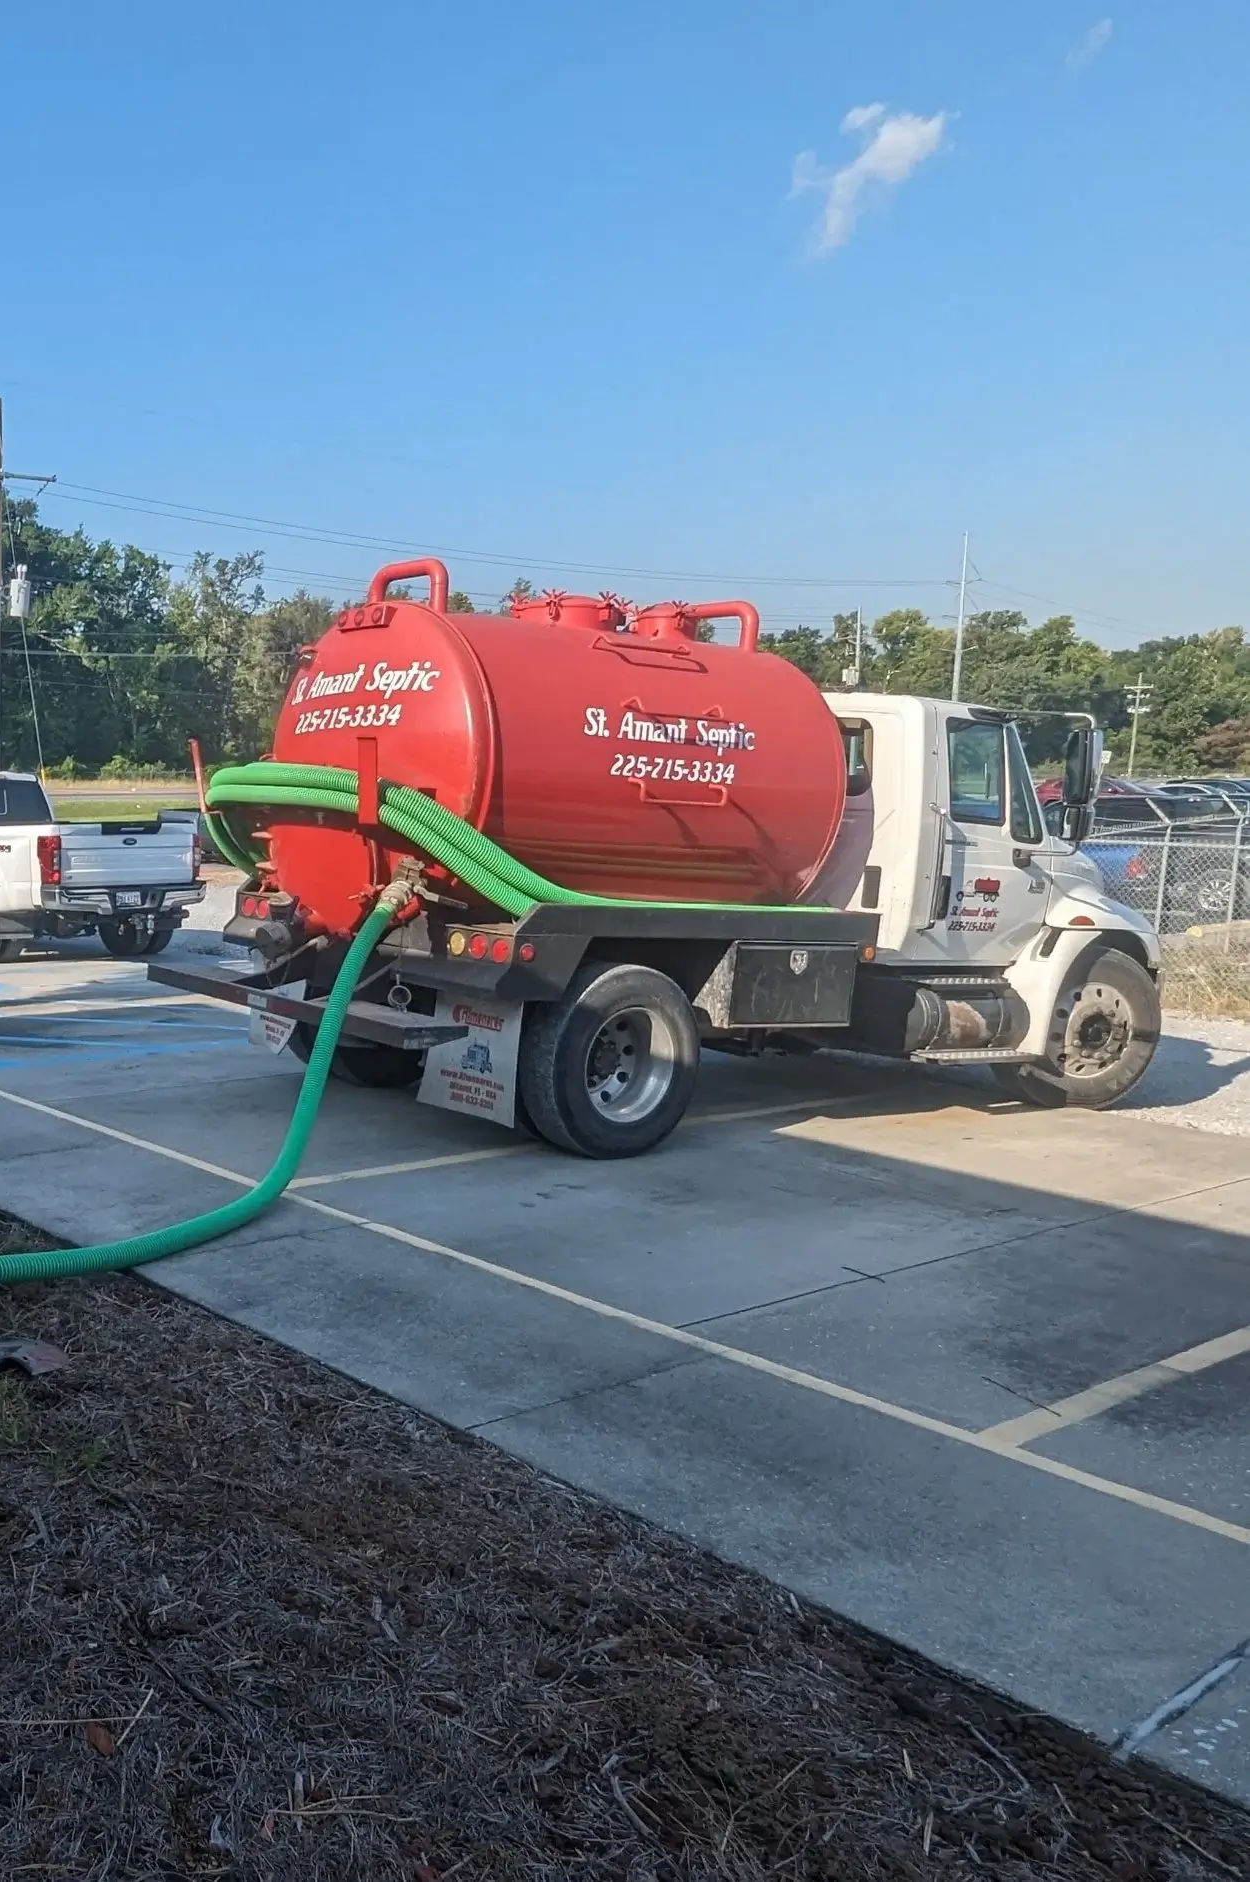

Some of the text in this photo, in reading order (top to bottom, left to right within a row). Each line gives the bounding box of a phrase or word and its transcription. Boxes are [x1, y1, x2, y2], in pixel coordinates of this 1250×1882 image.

[306, 664, 366, 700] Amant
[365, 661, 440, 699] Septic
[295, 704, 402, 735] 225-715-3334
[584, 707, 756, 756] St. Amant Septic
[610, 754, 735, 785] 225-715-3334
[948, 921, 996, 932] 225-715-3334
